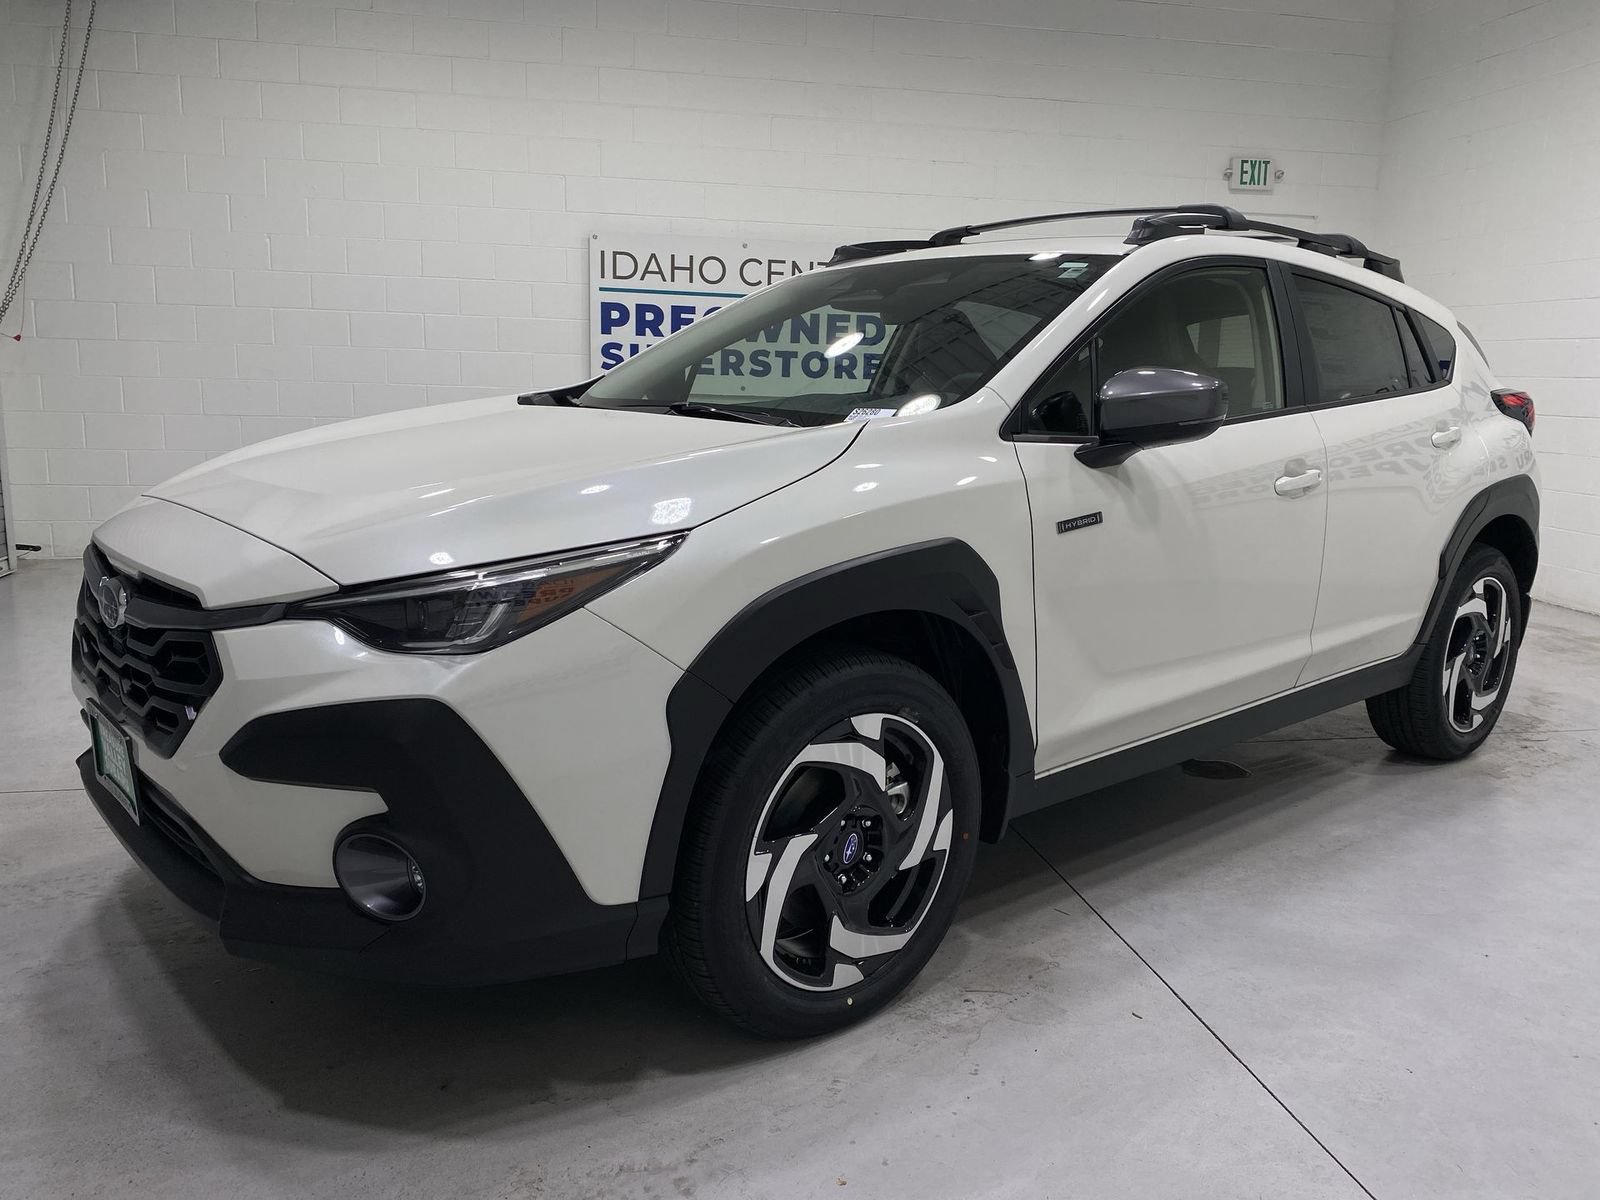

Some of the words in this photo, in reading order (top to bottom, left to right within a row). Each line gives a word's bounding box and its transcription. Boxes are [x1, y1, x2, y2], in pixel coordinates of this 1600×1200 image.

[1240, 160, 1271, 186] EXIT
[600, 249, 727, 285] IDAHO
[739, 257, 829, 287] CEN
[600, 301, 887, 347] PREWNED
[600, 342, 887, 380] SERSTORE
[1065, 516, 1096, 529] HYBRID
